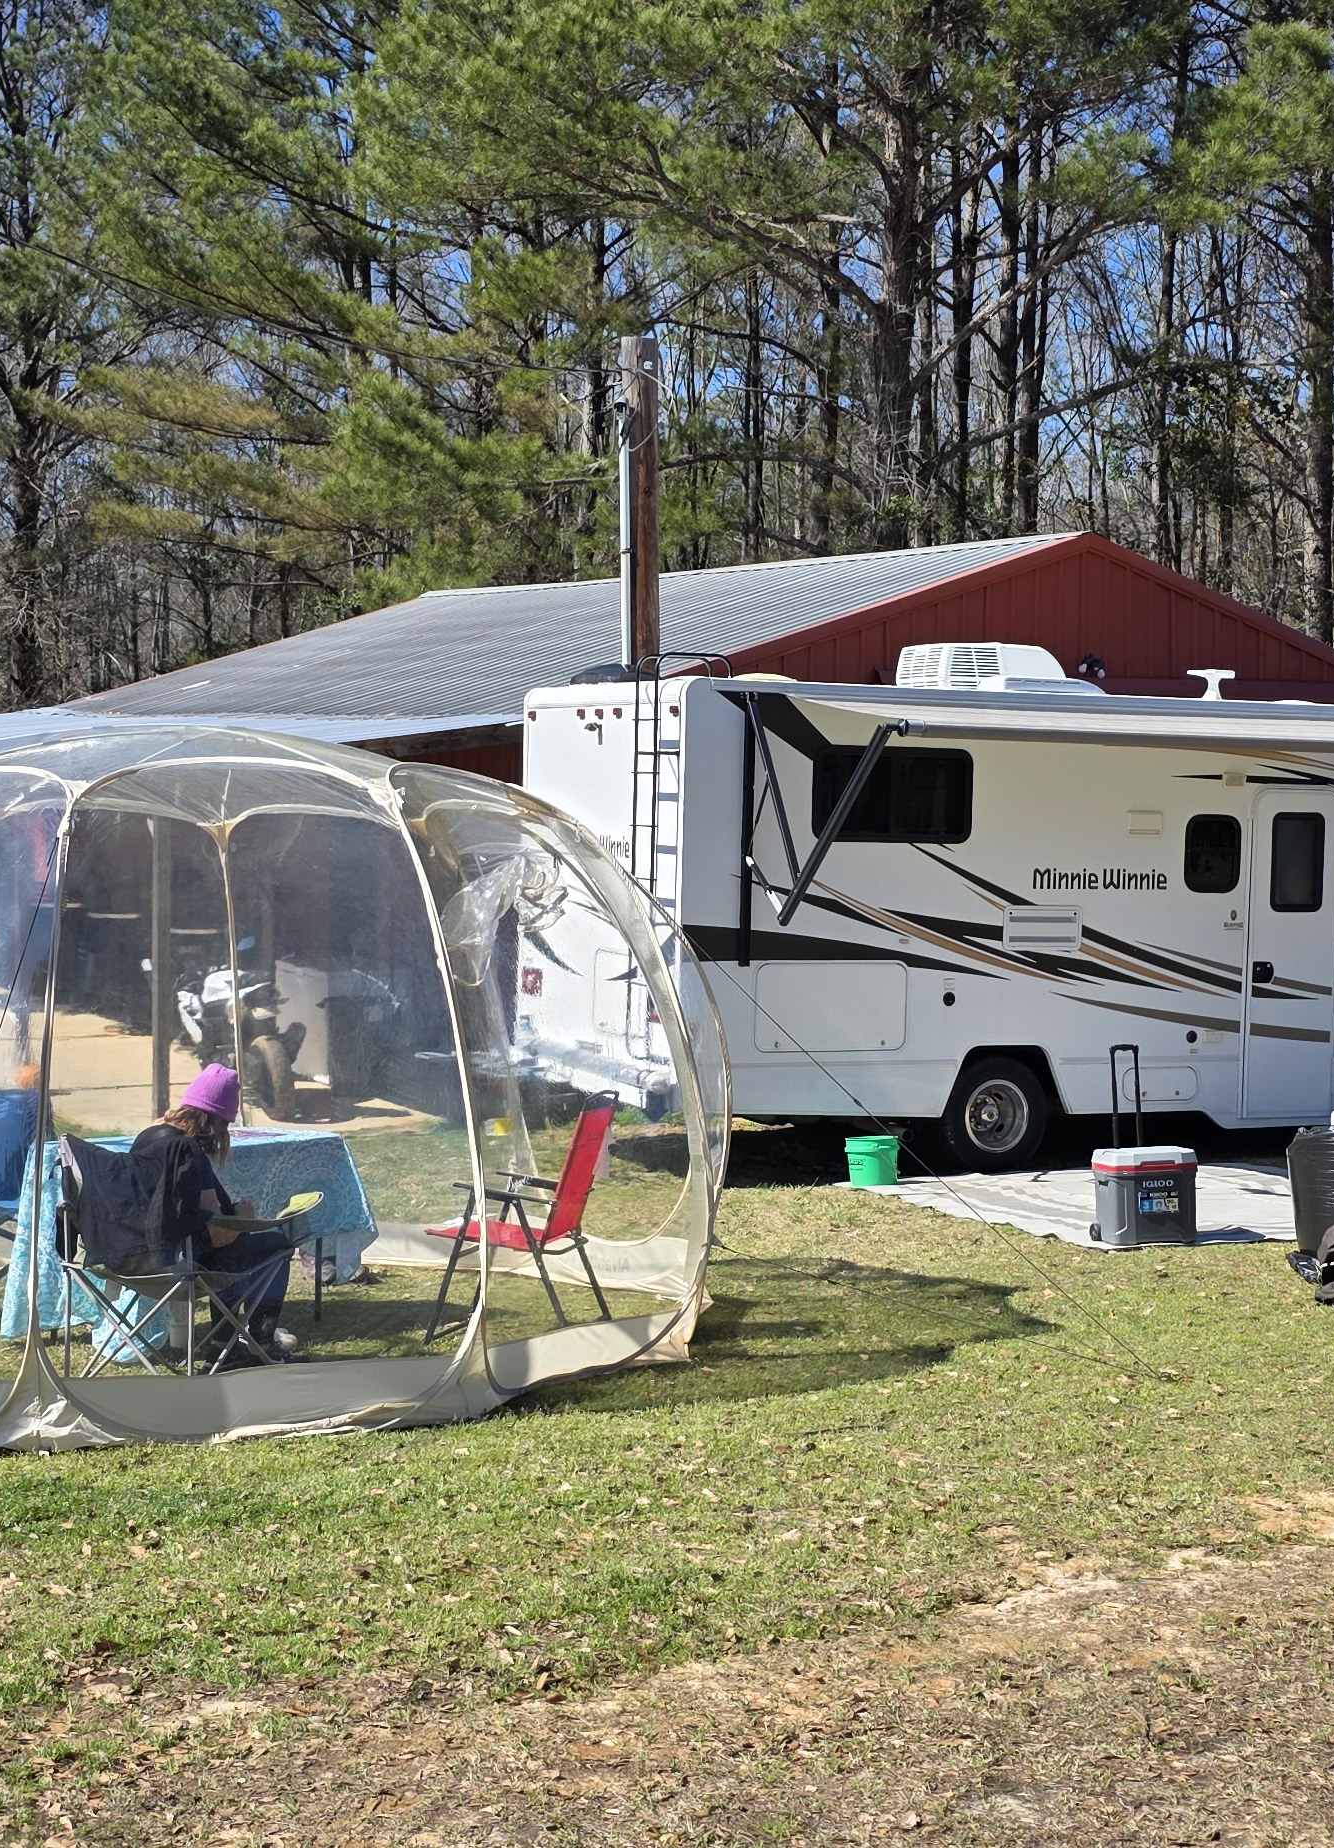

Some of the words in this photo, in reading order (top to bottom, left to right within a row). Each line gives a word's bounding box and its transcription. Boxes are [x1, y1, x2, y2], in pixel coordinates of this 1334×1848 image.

[1032, 868, 1099, 890] Minnie
[1102, 868, 1168, 890] Winnie
[1142, 1179, 1174, 1188] IGLOO
